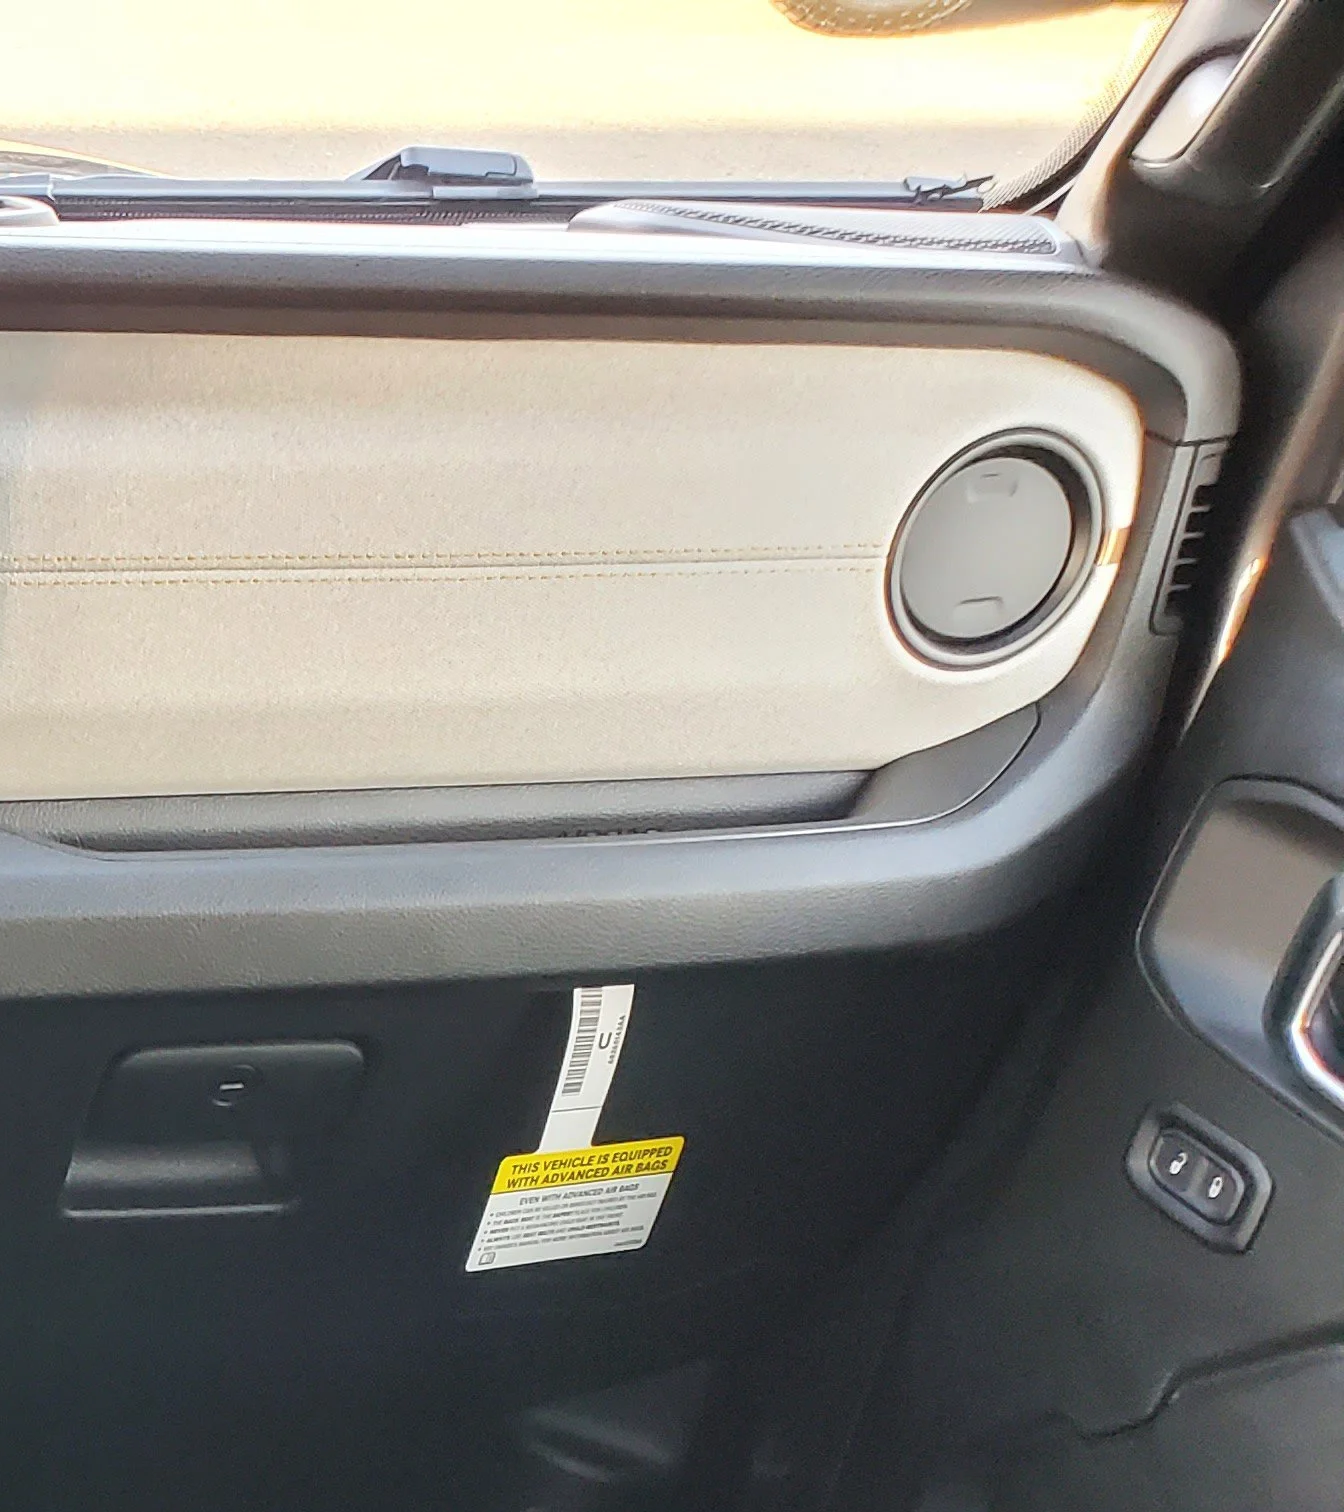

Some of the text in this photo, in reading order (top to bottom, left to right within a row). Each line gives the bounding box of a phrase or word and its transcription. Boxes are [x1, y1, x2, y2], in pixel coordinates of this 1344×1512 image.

[506, 1159, 669, 1190] WITH ADVANCED AIR BAGS
[511, 1145, 674, 1176] THIS VEHICLE IS EQUIPPED
